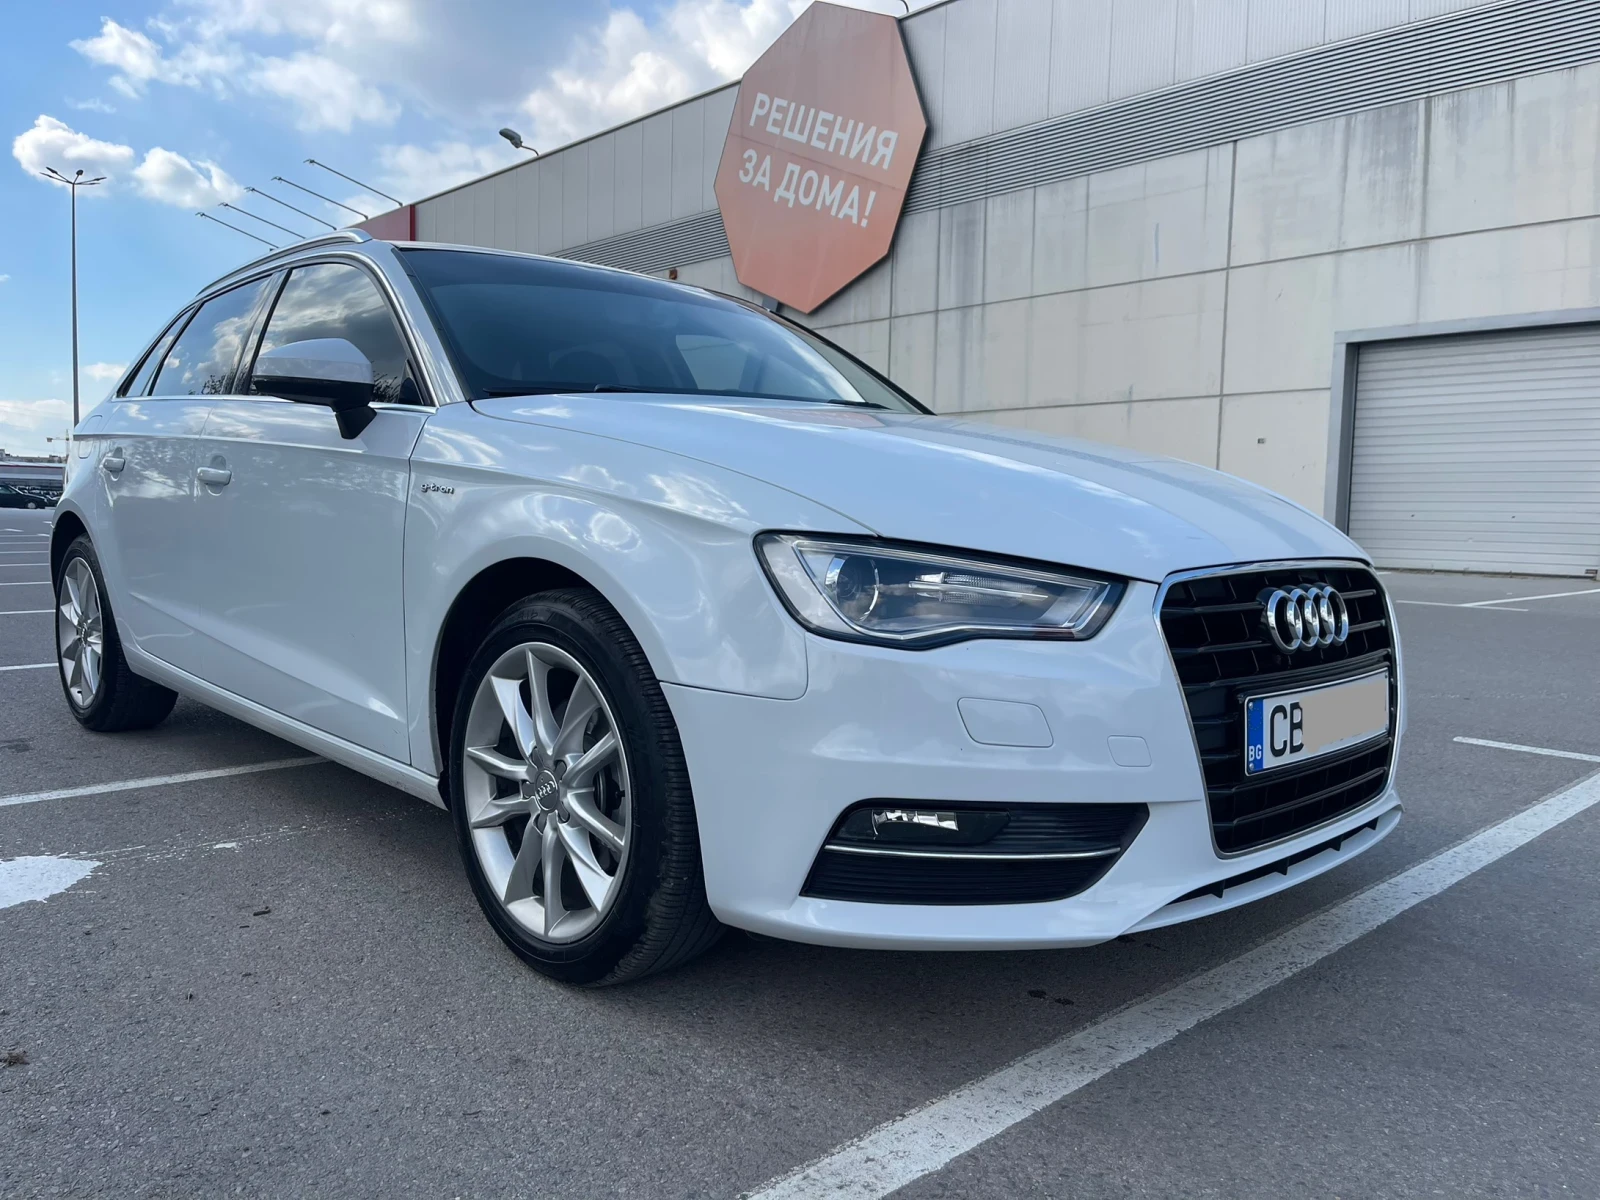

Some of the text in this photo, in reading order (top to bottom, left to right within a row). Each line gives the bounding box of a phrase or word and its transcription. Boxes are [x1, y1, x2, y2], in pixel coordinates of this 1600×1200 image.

[749, 92, 899, 170] РЕШЕНИЯ
[738, 148, 876, 228] ЗА ДОМА!
[420, 482, 455, 495] g-tron
[1248, 744, 1262, 761] BG
